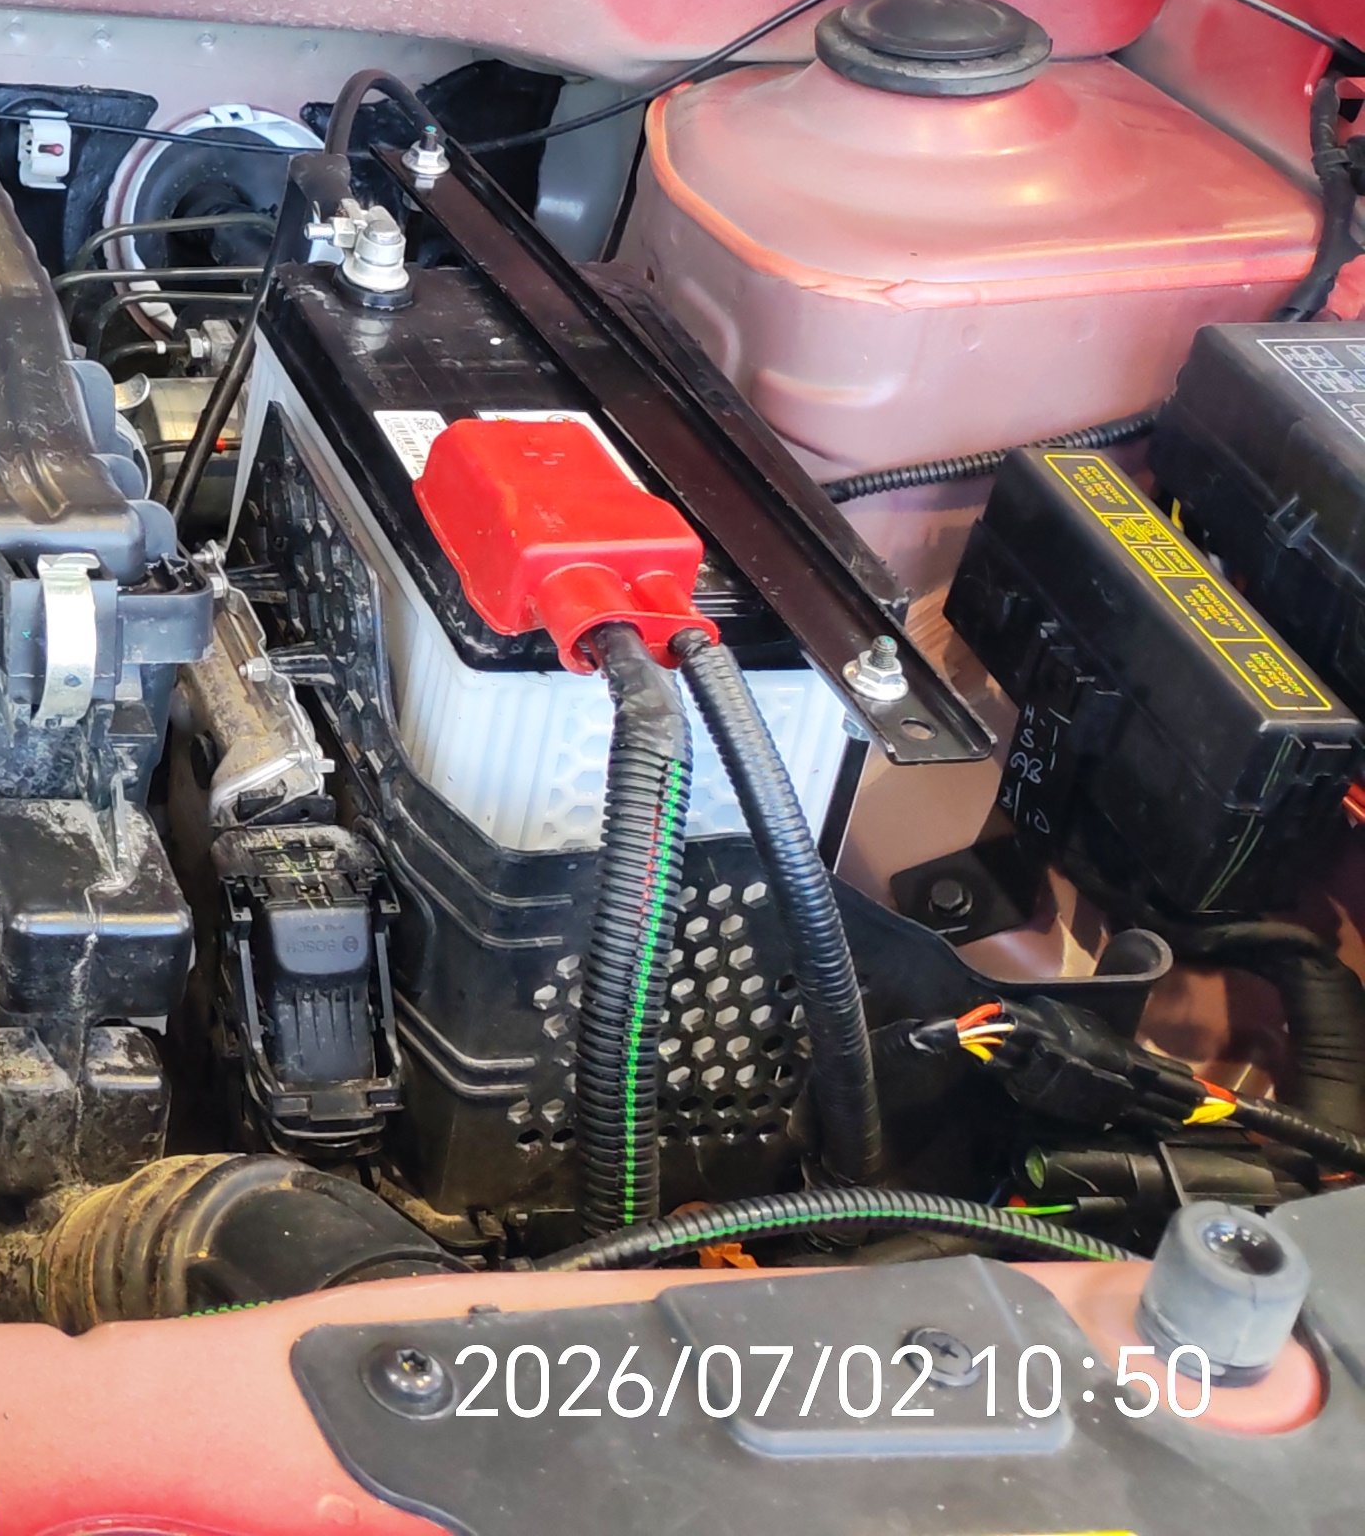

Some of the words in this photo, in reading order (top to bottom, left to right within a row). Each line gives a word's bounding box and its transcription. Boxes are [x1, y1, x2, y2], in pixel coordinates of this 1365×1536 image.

[1101, 481, 1129, 505] POWER
[1196, 583, 1235, 618] RADIATOR
[1229, 616, 1248, 632] FAN
[1204, 604, 1232, 627] RELAY
[1258, 650, 1308, 697] ACCESSORY
[1265, 669, 1295, 695] RELAY
[286, 940, 337, 953] BOSCH
